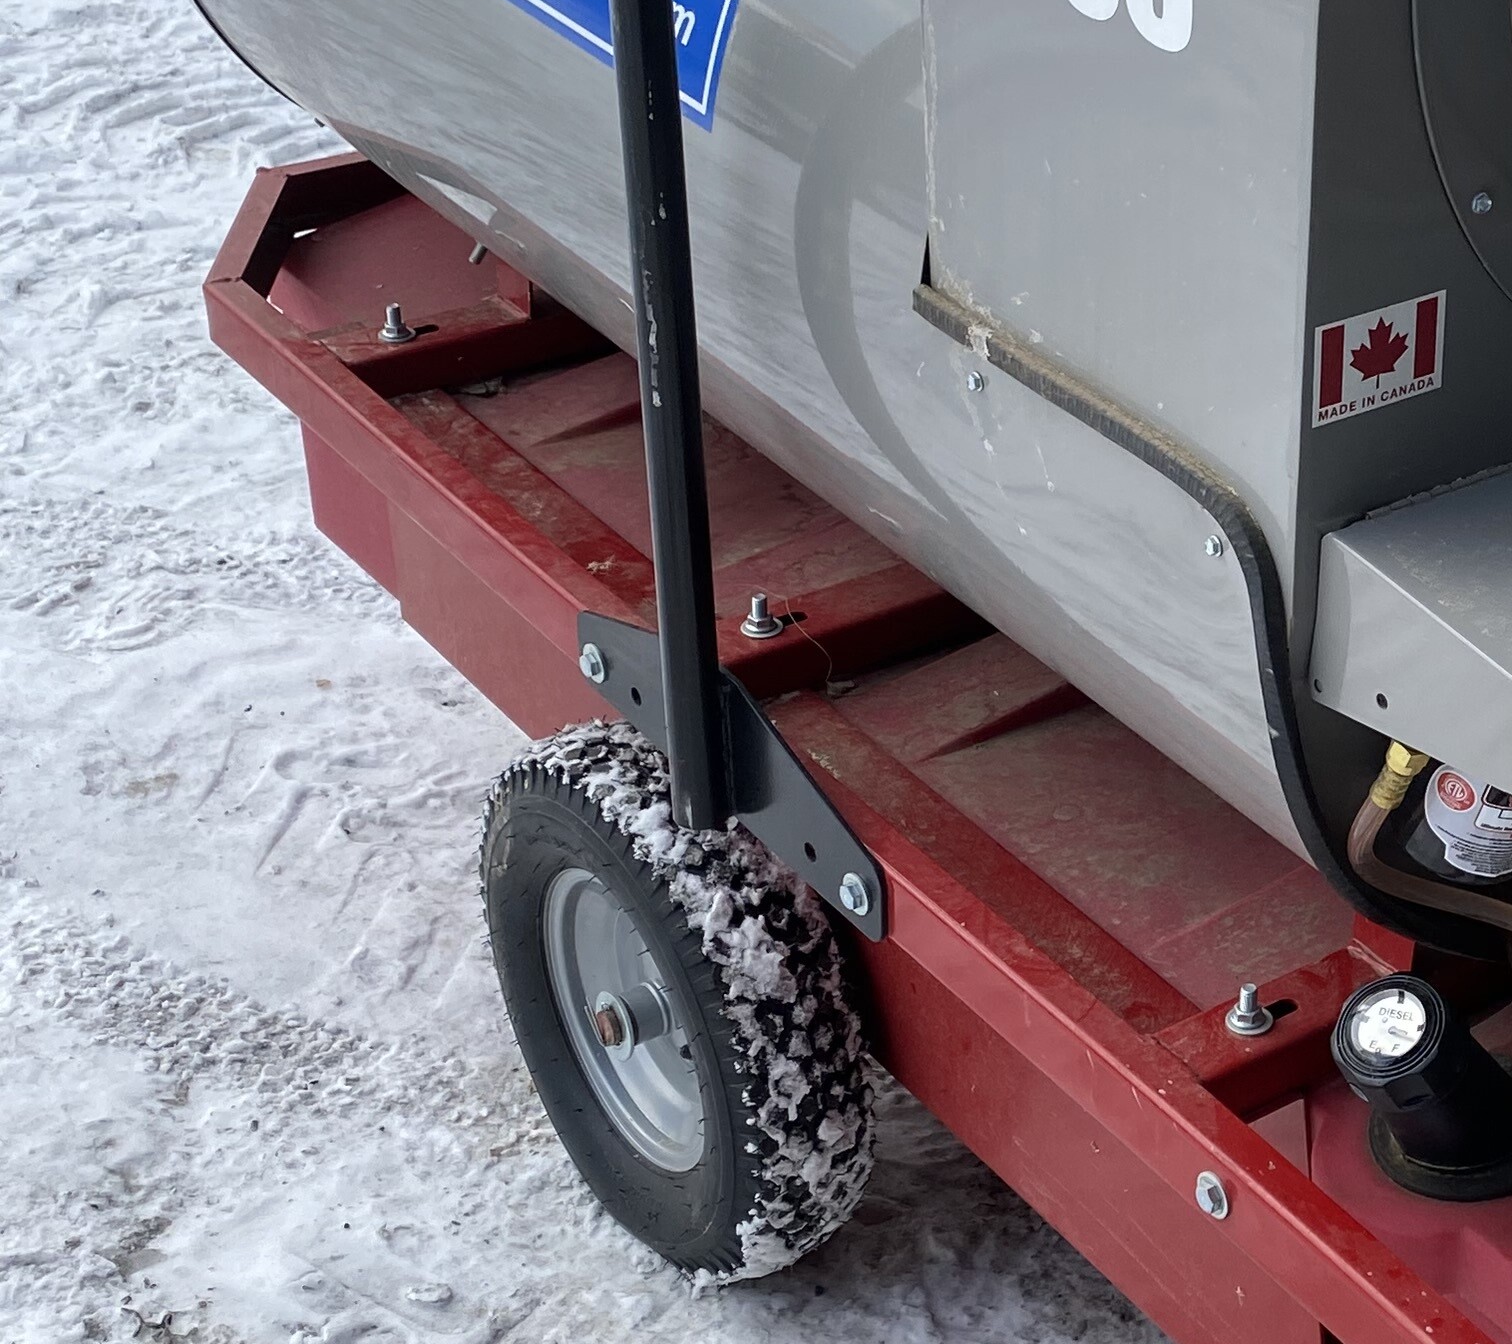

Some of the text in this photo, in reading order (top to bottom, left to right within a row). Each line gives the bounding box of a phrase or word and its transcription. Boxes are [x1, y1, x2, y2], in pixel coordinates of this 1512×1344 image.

[1317, 377, 1435, 422] MADE IN CANADA
[1378, 1007, 1414, 1022] DIESEL
[1368, 1039, 1401, 1053] E F
